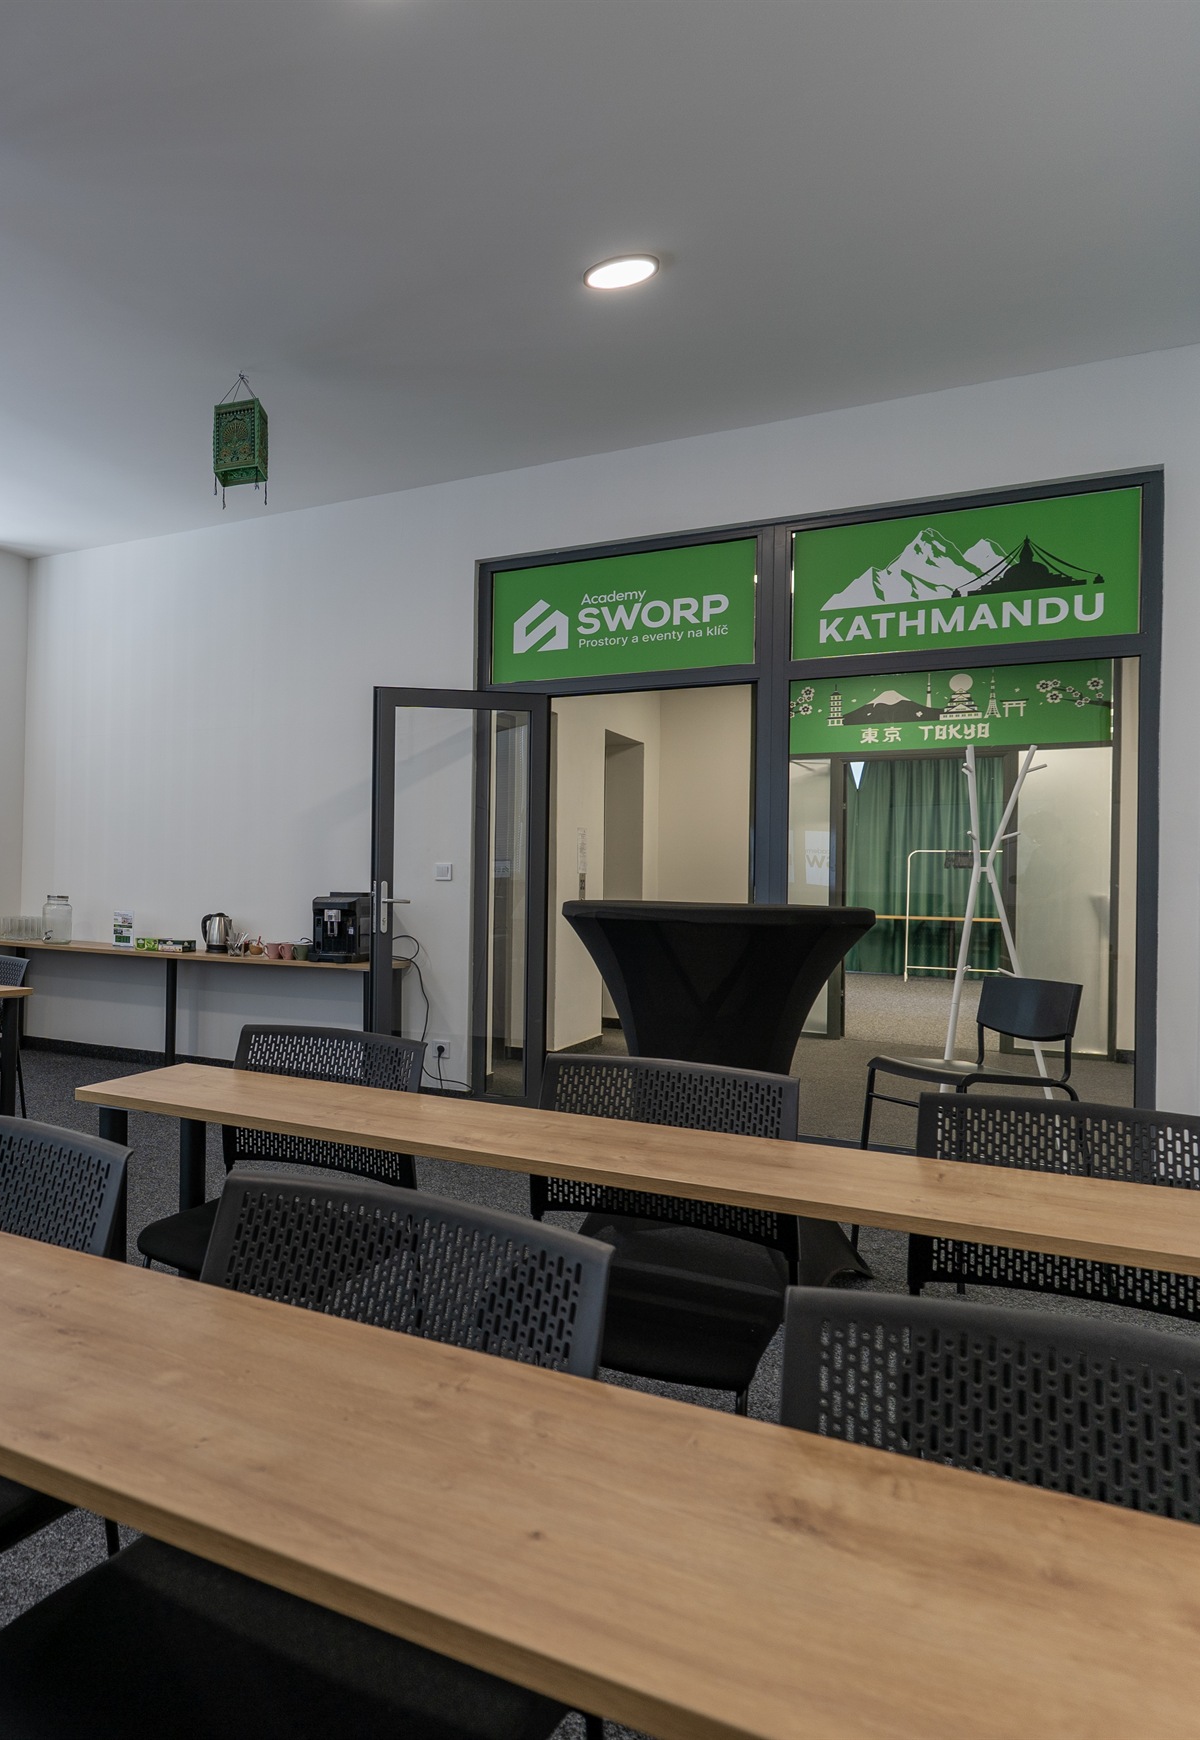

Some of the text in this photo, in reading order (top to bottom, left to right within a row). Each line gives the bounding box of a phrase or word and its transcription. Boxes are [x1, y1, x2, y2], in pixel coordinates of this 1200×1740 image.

[580, 589, 647, 606] Academy
[576, 593, 730, 635] SWORP
[819, 592, 1105, 644] KATHMANDU
[578, 624, 729, 648] Prostory a eventy na klíč
[860, 726, 902, 744] 東京
[918, 722, 991, 741] TOKYO
